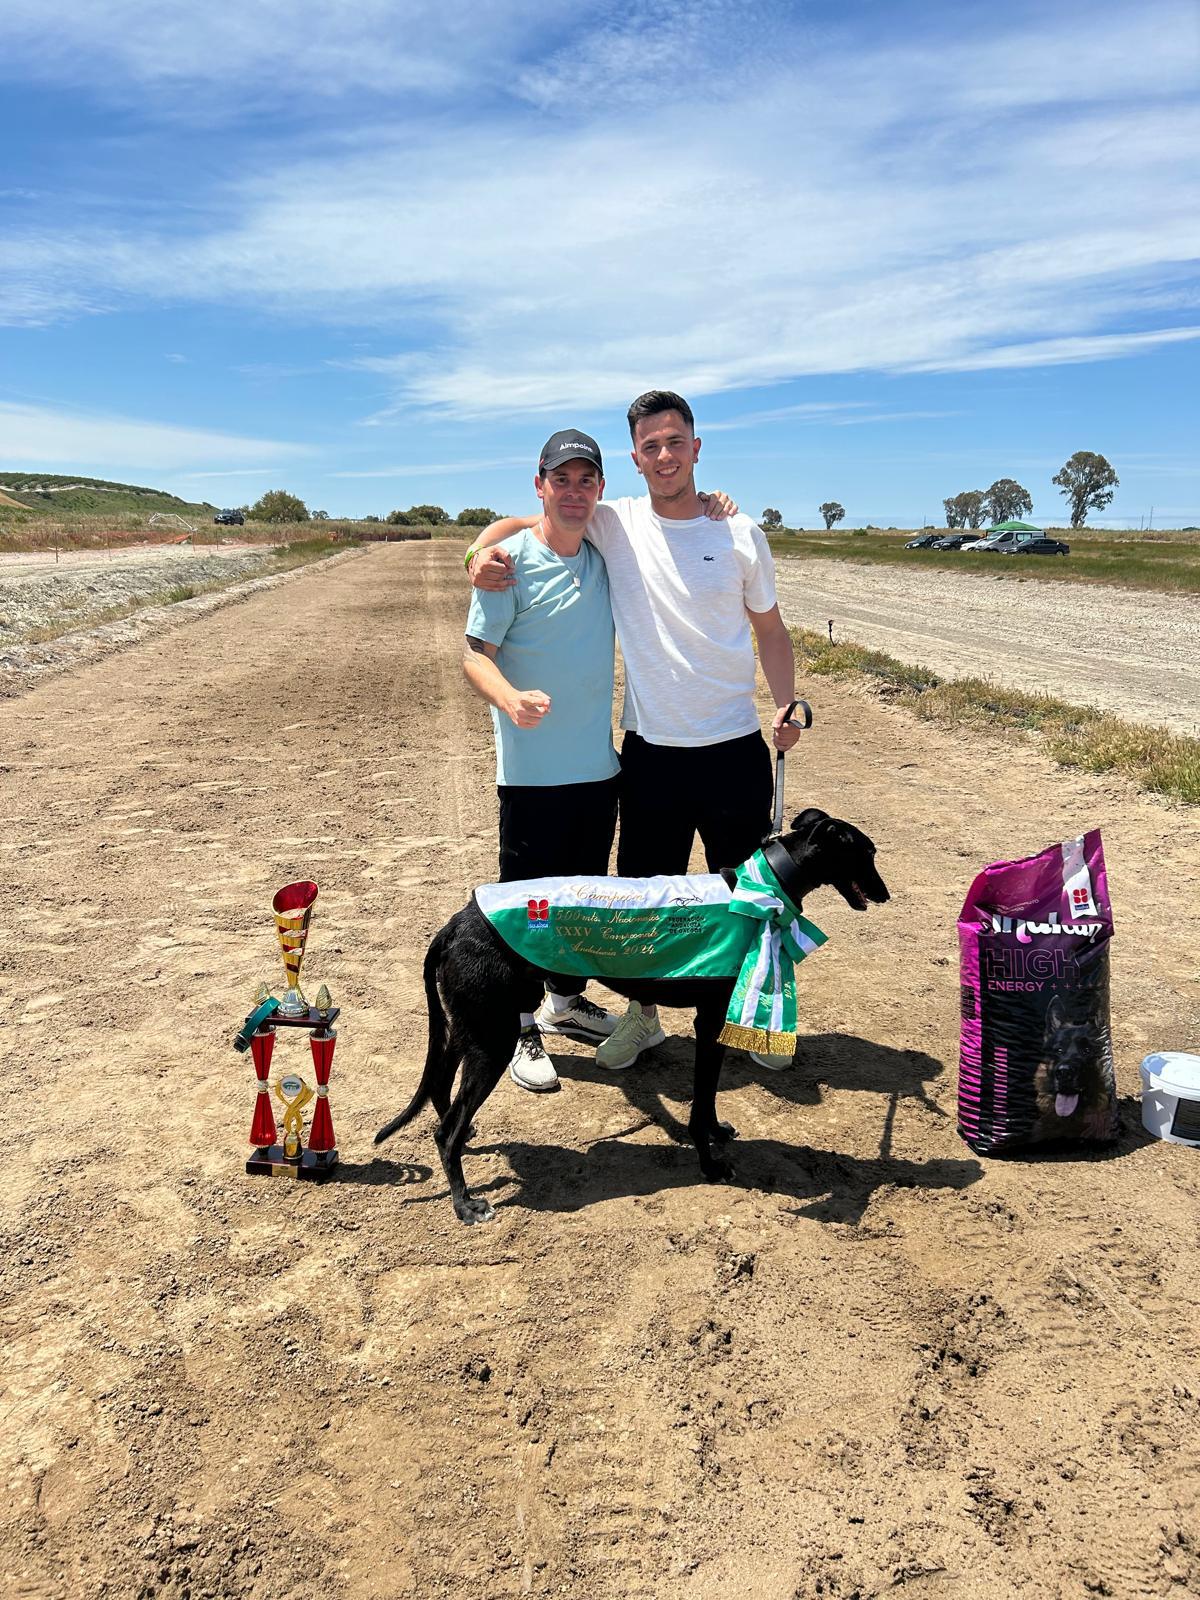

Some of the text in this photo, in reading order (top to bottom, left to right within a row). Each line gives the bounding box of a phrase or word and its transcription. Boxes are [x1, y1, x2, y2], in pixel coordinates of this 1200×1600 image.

[555, 926, 592, 937] XXXV
[623, 944, 656, 955] 2024
[986, 948, 1080, 980] HIGH
[987, 980, 1045, 992] ENERGY
